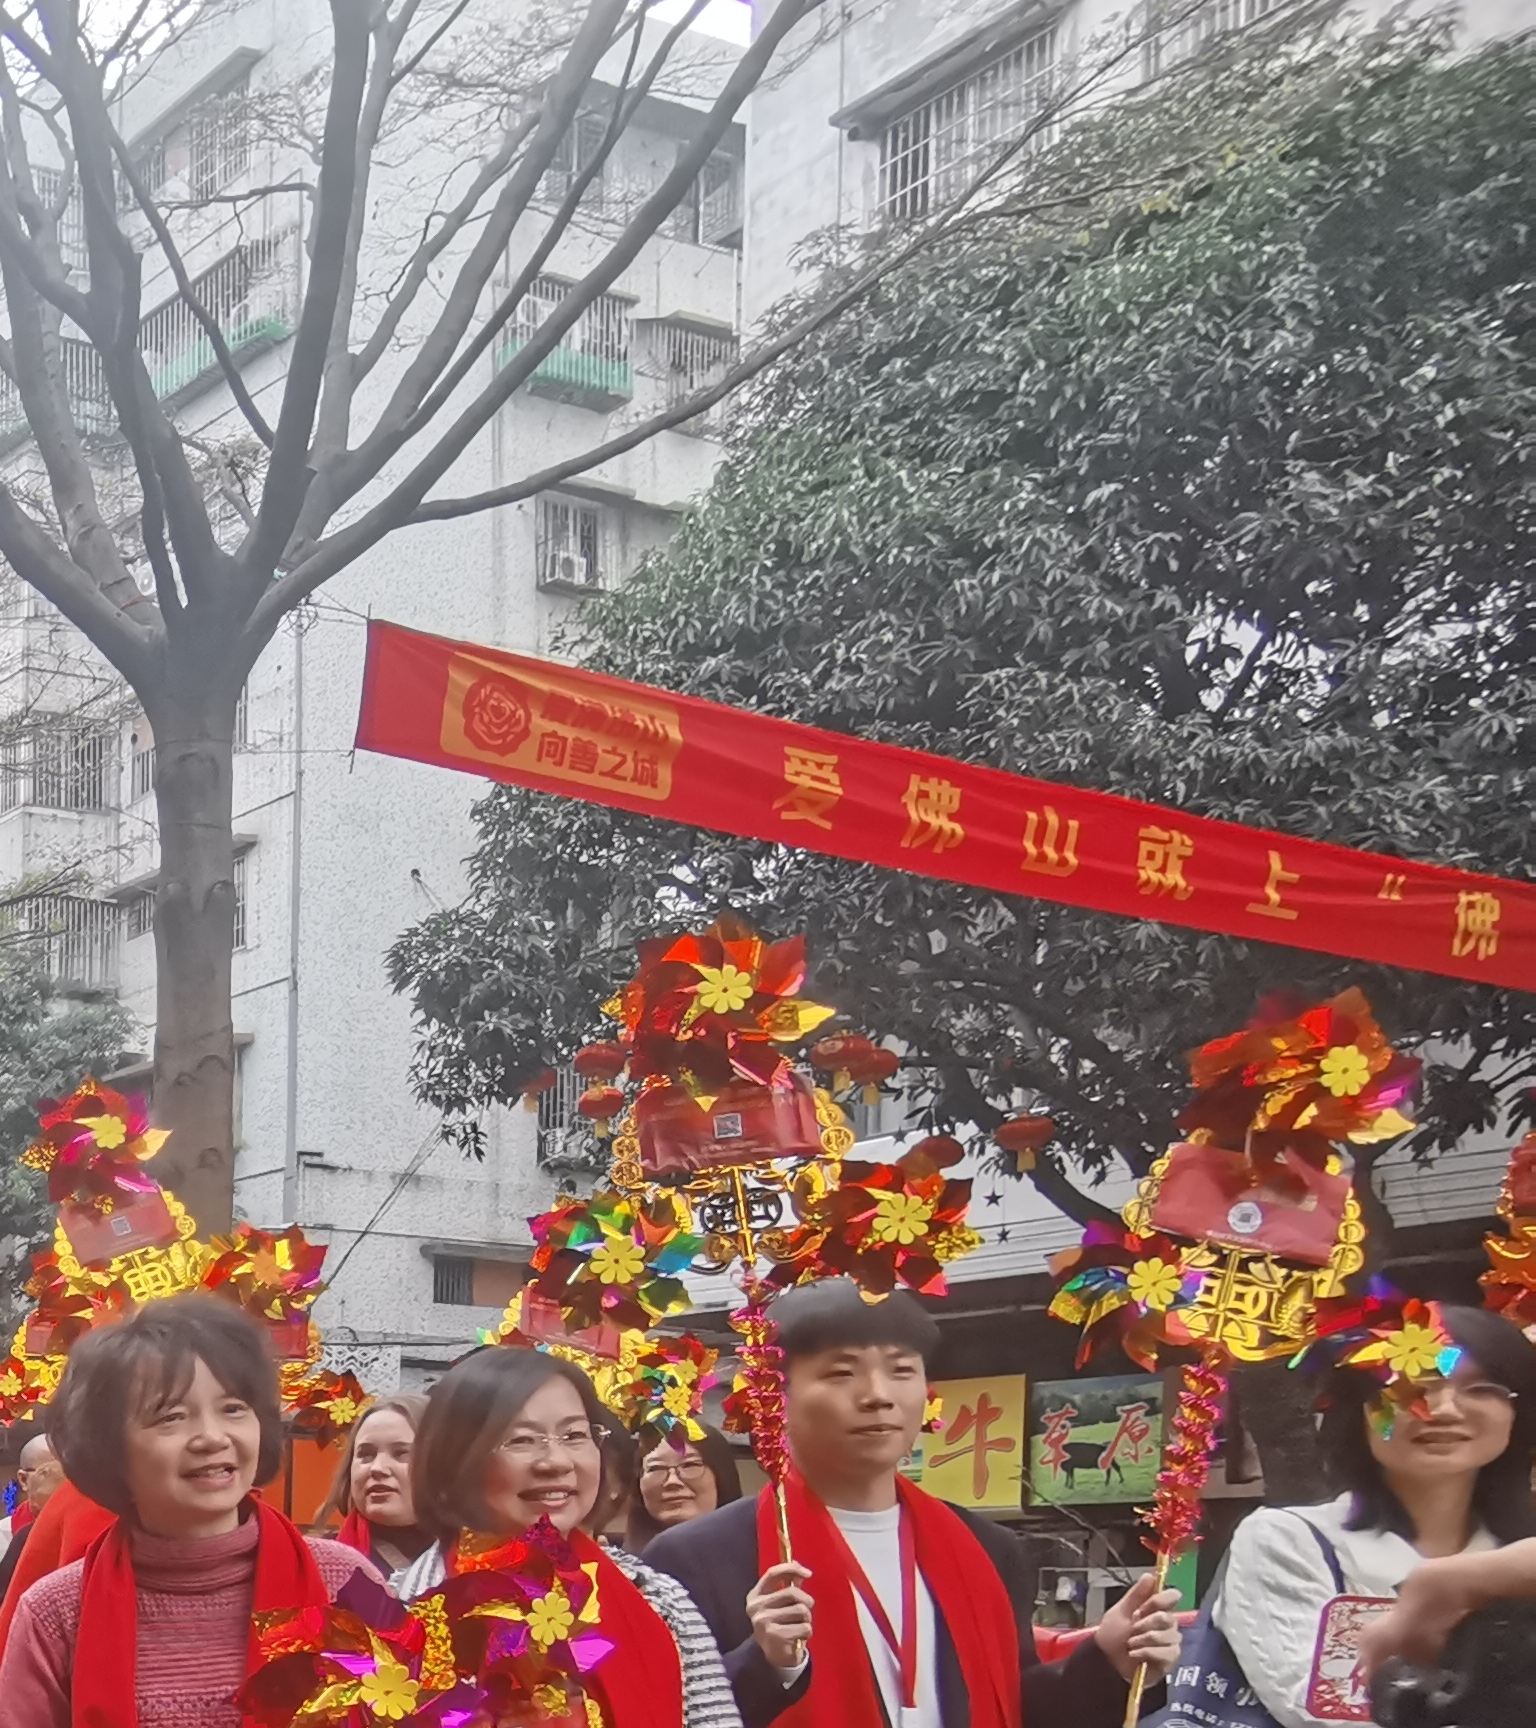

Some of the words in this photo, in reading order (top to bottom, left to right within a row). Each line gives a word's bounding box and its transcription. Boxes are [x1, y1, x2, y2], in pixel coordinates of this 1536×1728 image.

[536, 730, 659, 789] 向善之城
[928, 1392, 1016, 1500] 牛
[1040, 1402, 1154, 1481] 草原
